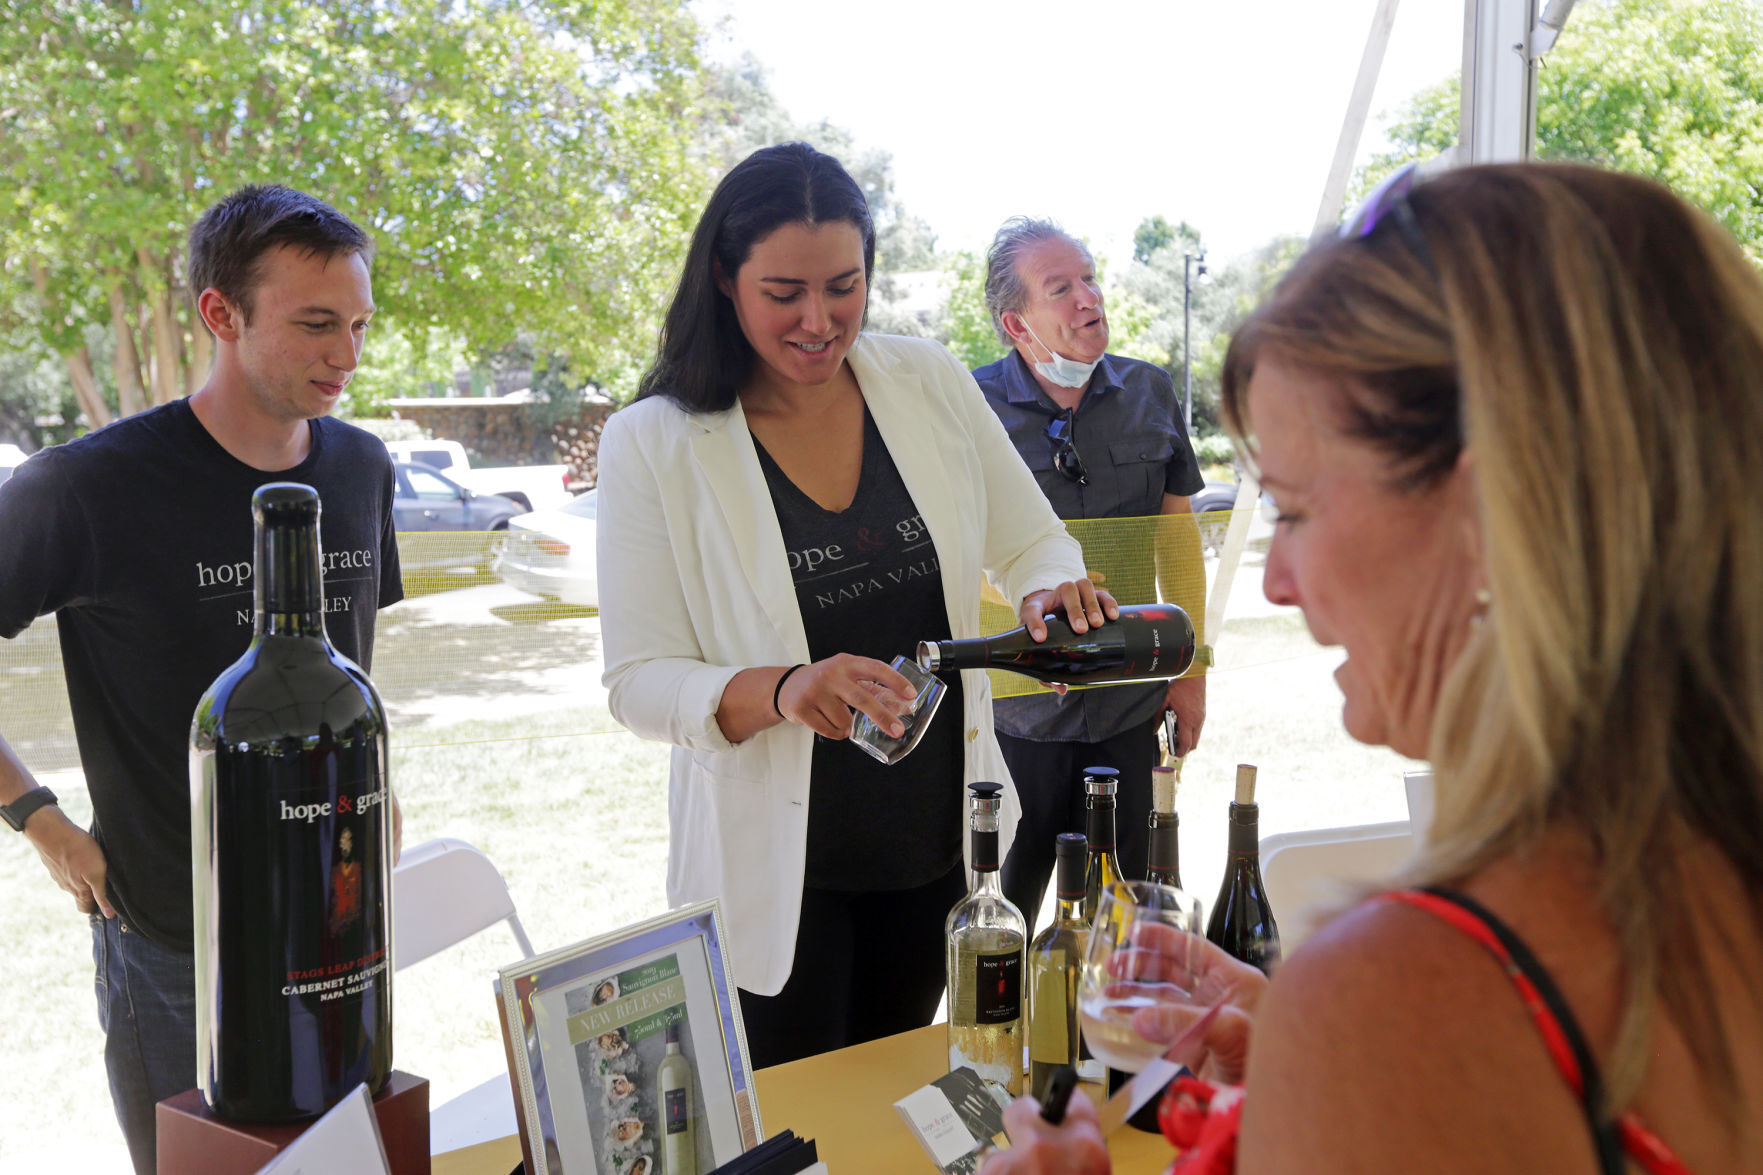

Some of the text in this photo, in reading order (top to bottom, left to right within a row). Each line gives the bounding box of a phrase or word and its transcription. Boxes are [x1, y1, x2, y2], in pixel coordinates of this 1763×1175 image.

[788, 543, 845, 572] ope
[856, 527, 887, 551] &
[196, 561, 254, 587] hop
[325, 597, 352, 613] LEY
[815, 578, 884, 609] NAPA
[280, 800, 332, 824] hope
[337, 795, 353, 813] &
[287, 967, 325, 981] STAGS
[327, 961, 356, 975] LEAP
[622, 972, 658, 992] Sauvignon
[281, 977, 345, 996] CABERNET
[320, 979, 374, 1002] NAPA VALLEY
[581, 985, 676, 1031] NEW RELEASE
